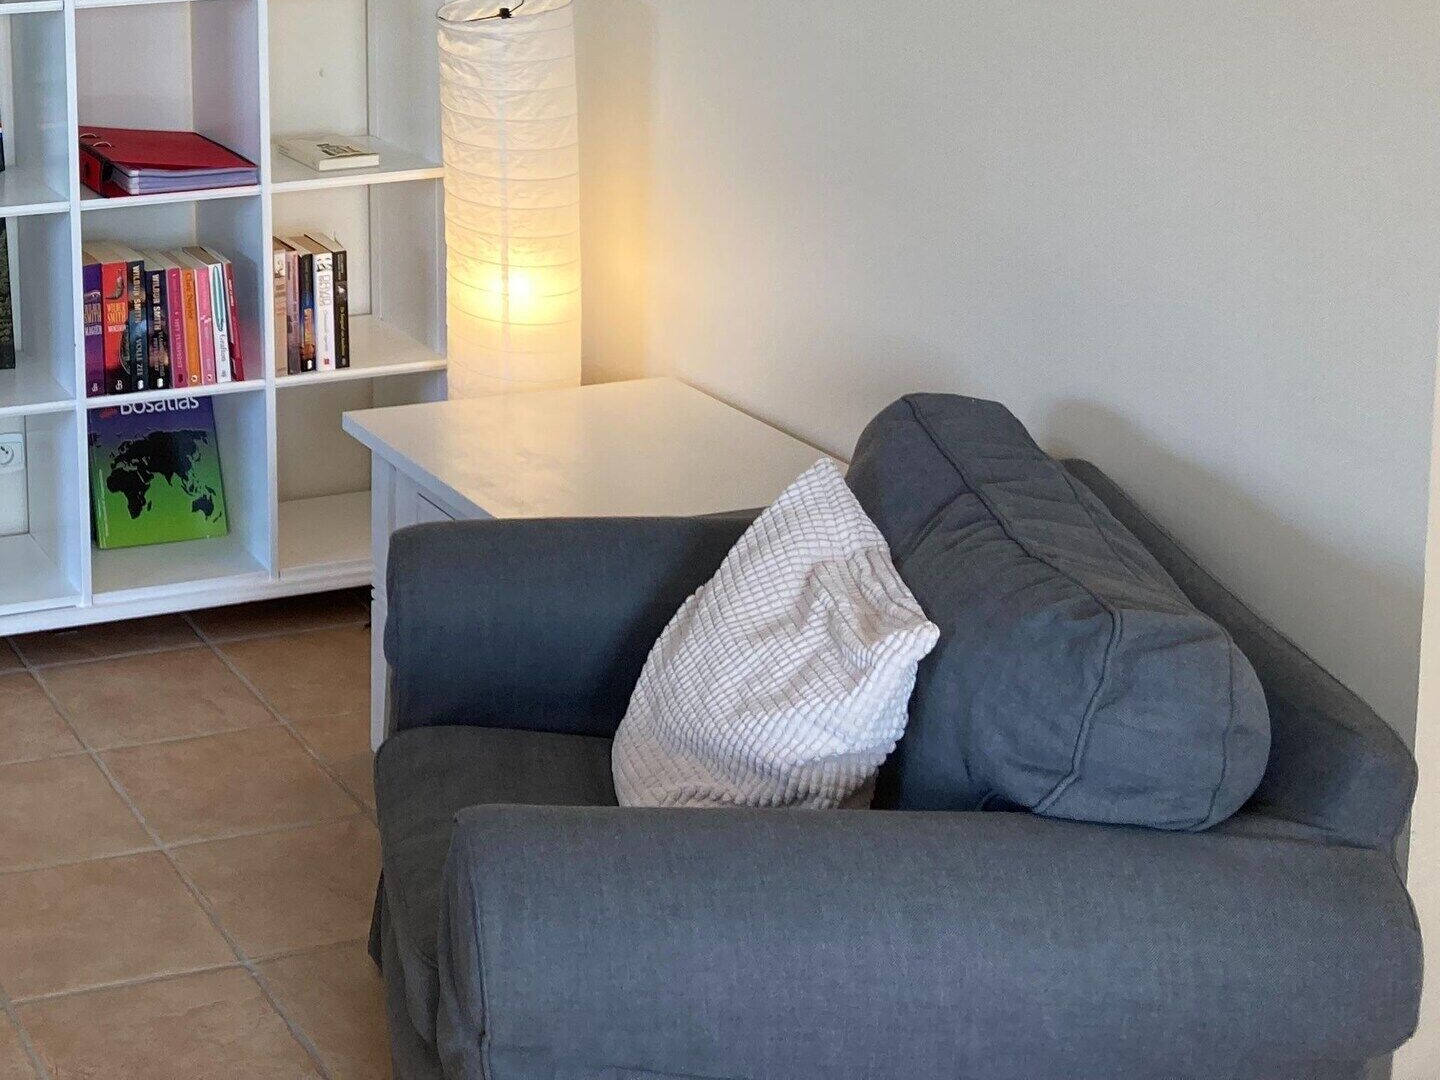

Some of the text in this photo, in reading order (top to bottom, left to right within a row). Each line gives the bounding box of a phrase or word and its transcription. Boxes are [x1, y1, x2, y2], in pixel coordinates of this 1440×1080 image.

[132, 266, 141, 296] WILBUR
[152, 274, 161, 303] WILBUR
[154, 306, 162, 330] SMITH
[219, 334, 227, 362] Grafton
